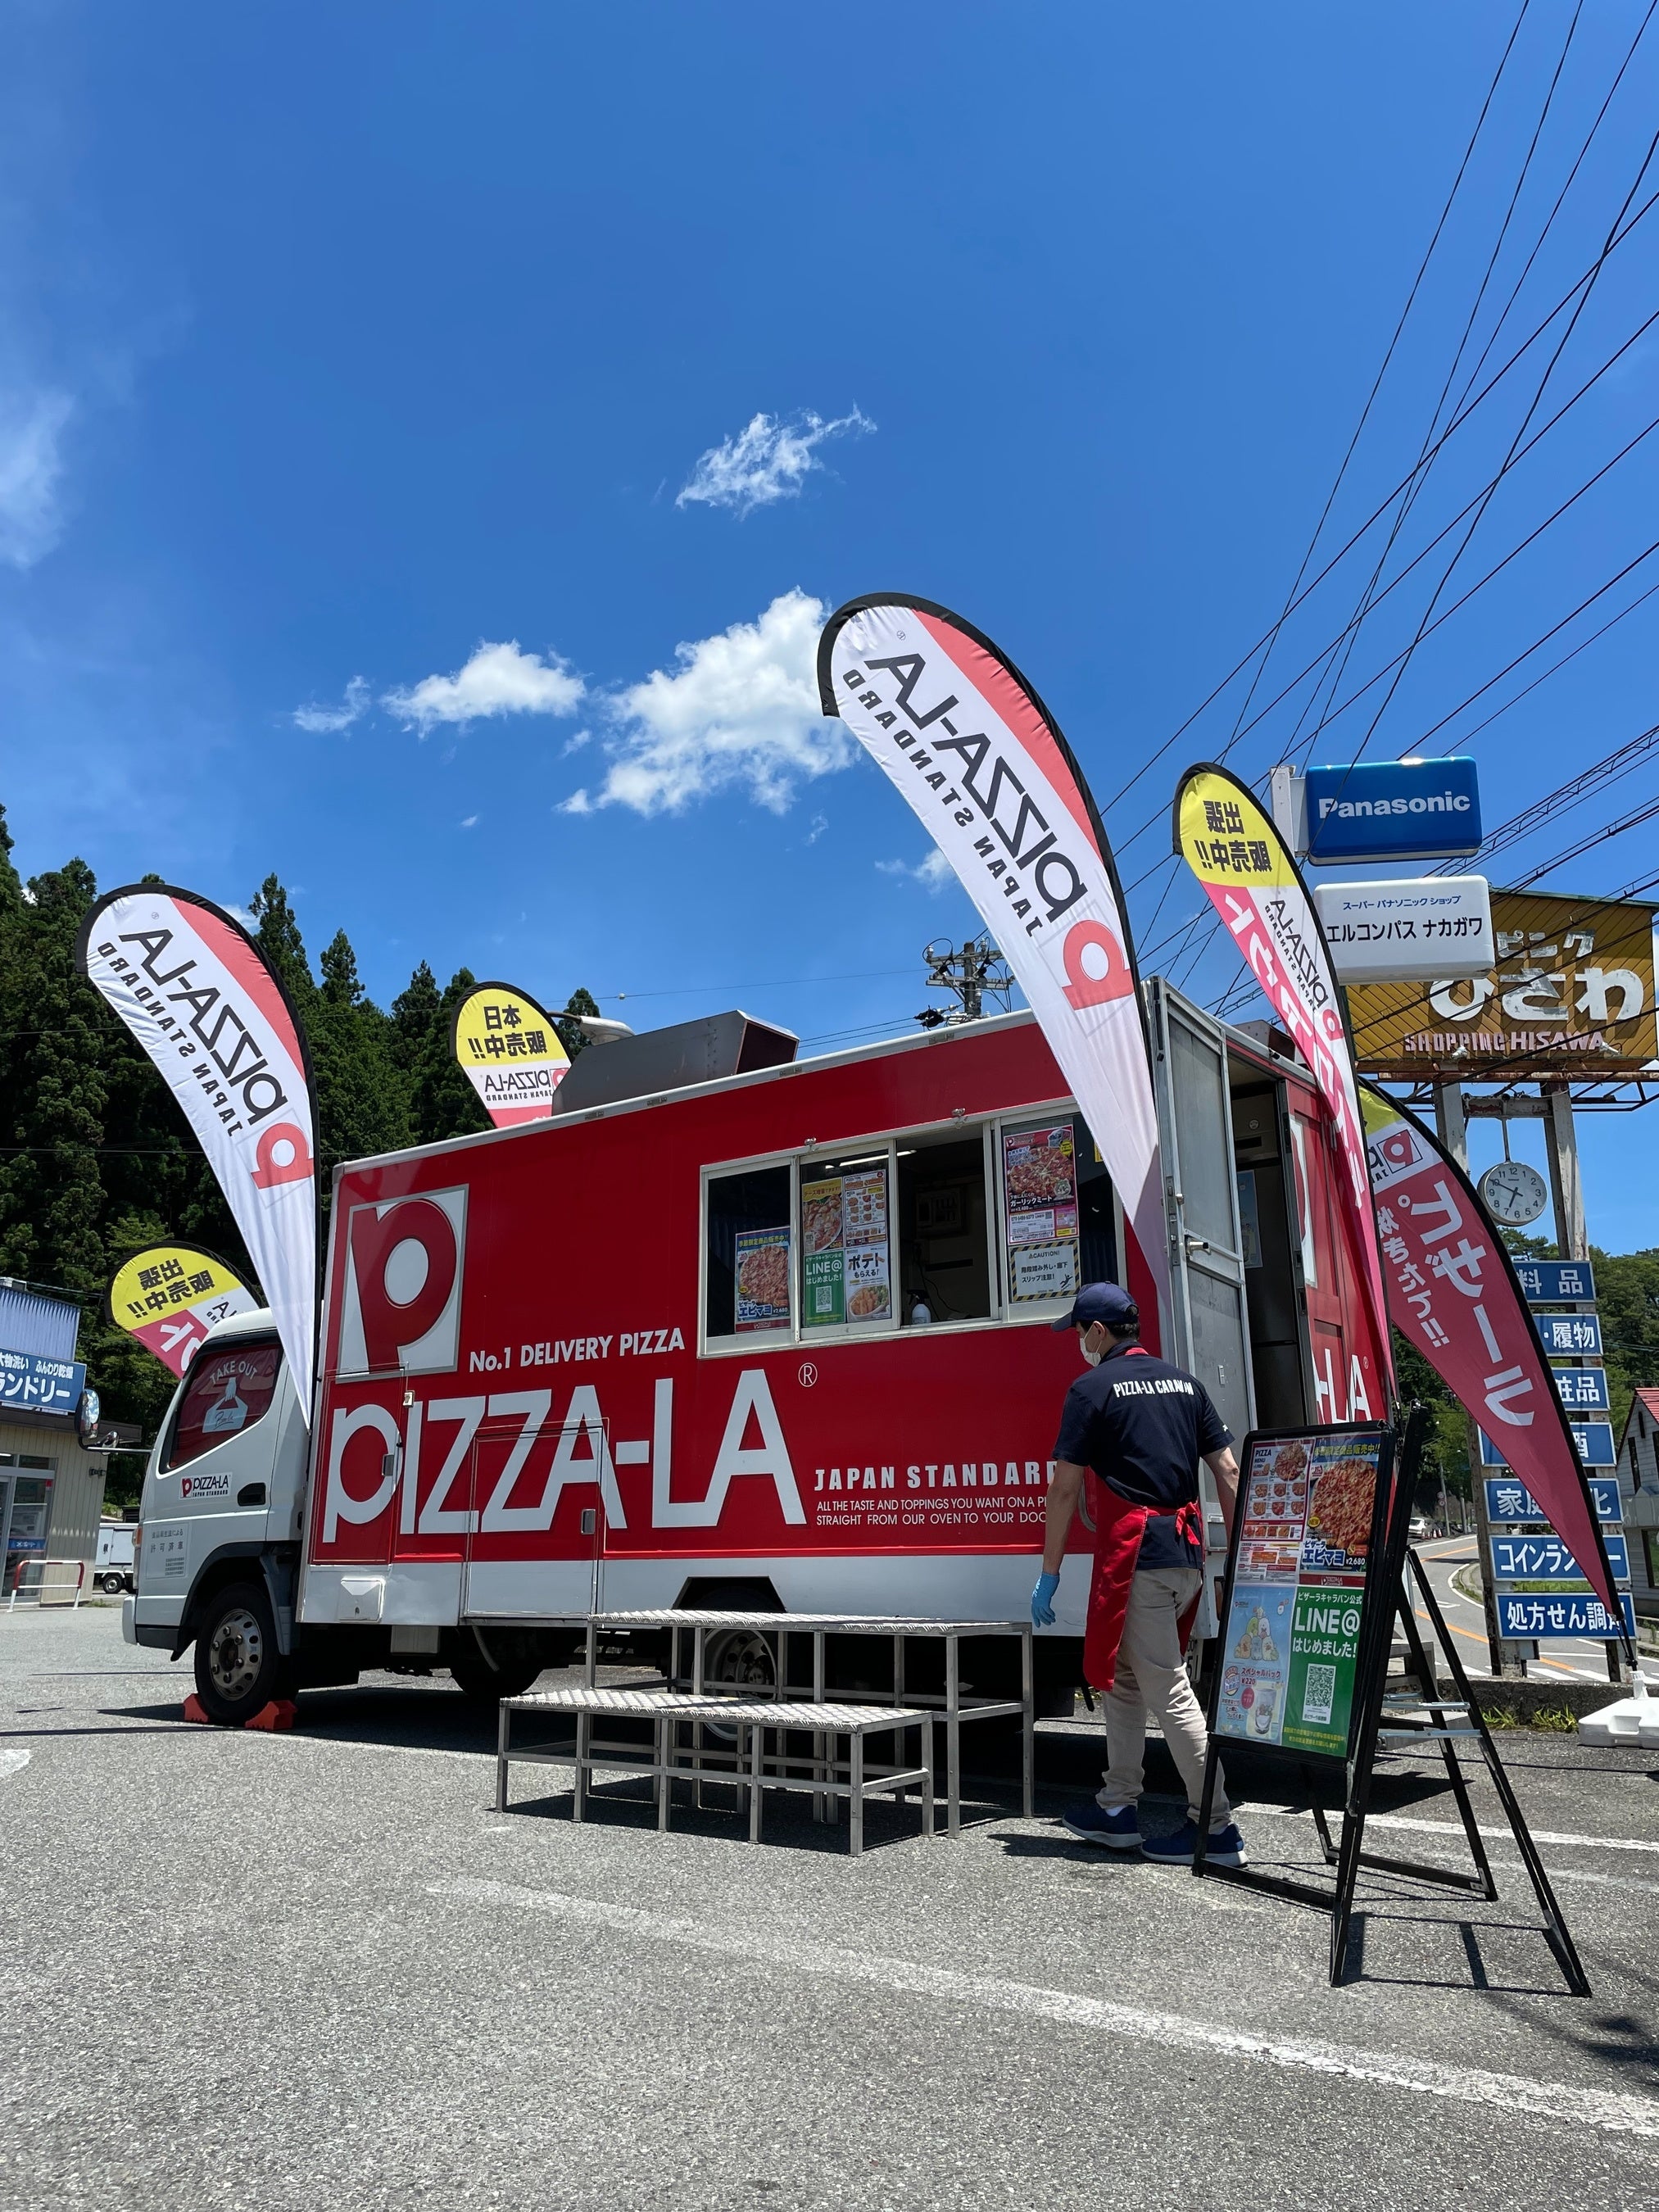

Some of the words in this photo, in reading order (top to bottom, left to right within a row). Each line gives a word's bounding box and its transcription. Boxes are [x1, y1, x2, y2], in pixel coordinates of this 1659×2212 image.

[1318, 791, 1471, 819] Panasonic
[1343, 900, 1374, 910] スーパー
[1376, 897, 1427, 909] パナソニック
[1429, 895, 1462, 907] ショップ
[1326, 919, 1415, 944] エルコンパス
[1422, 917, 1482, 939] ナカガワ
[1428, 968, 1644, 1022] ひさわ
[1404, 1032, 1505, 1052] SHOPPING
[1512, 1031, 1604, 1051] HISAWA
[1530, 1177, 1537, 1185] 2
[1535, 1189, 1541, 1197] 3
[848, 1253, 886, 1271] ポテト
[1033, 1250, 1060, 1258] CAUTION!
[806, 1259, 842, 1276] LINE@
[806, 1274, 842, 1285] はじめました!
[469, 1347, 510, 1373] No.1
[520, 1335, 614, 1367] DELIVERY
[619, 1328, 685, 1357] PIZZA
[210, 1361, 236, 1385] TAKE
[238, 1361, 257, 1380] OUT
[1113, 1380, 1155, 1398] PIZZA-LA
[814, 1466, 895, 1491] JAPAN
[817, 1501, 831, 1512] ALL
[832, 1501, 849, 1511] THE
[850, 1500, 875, 1511] TASTE
[877, 1499, 899, 1511] AND
[900, 1498, 950, 1510] TOPPINGS
[950, 1498, 973, 1509] YOU
[975, 1498, 1004, 1508] WANT
[1007, 1497, 1025, 1508] ON
[1027, 1497, 1035, 1507] A
[817, 1515, 862, 1526] STRAIGHT
[868, 1514, 898, 1525] FROM
[902, 1513, 926, 1525] OUR
[931, 1513, 961, 1525] OVEN
[963, 1512, 979, 1524] TO
[983, 1512, 1014, 1523] YOUR
[1302, 1548, 1344, 1566] エビマヨ
[1498, 1543, 1621, 1573] コインランー
[1298, 1592, 1363, 1605] ピザーラキャラバン公式
[1294, 1607, 1360, 1637] LINE@
[1292, 1637, 1357, 1658] はじめました!
